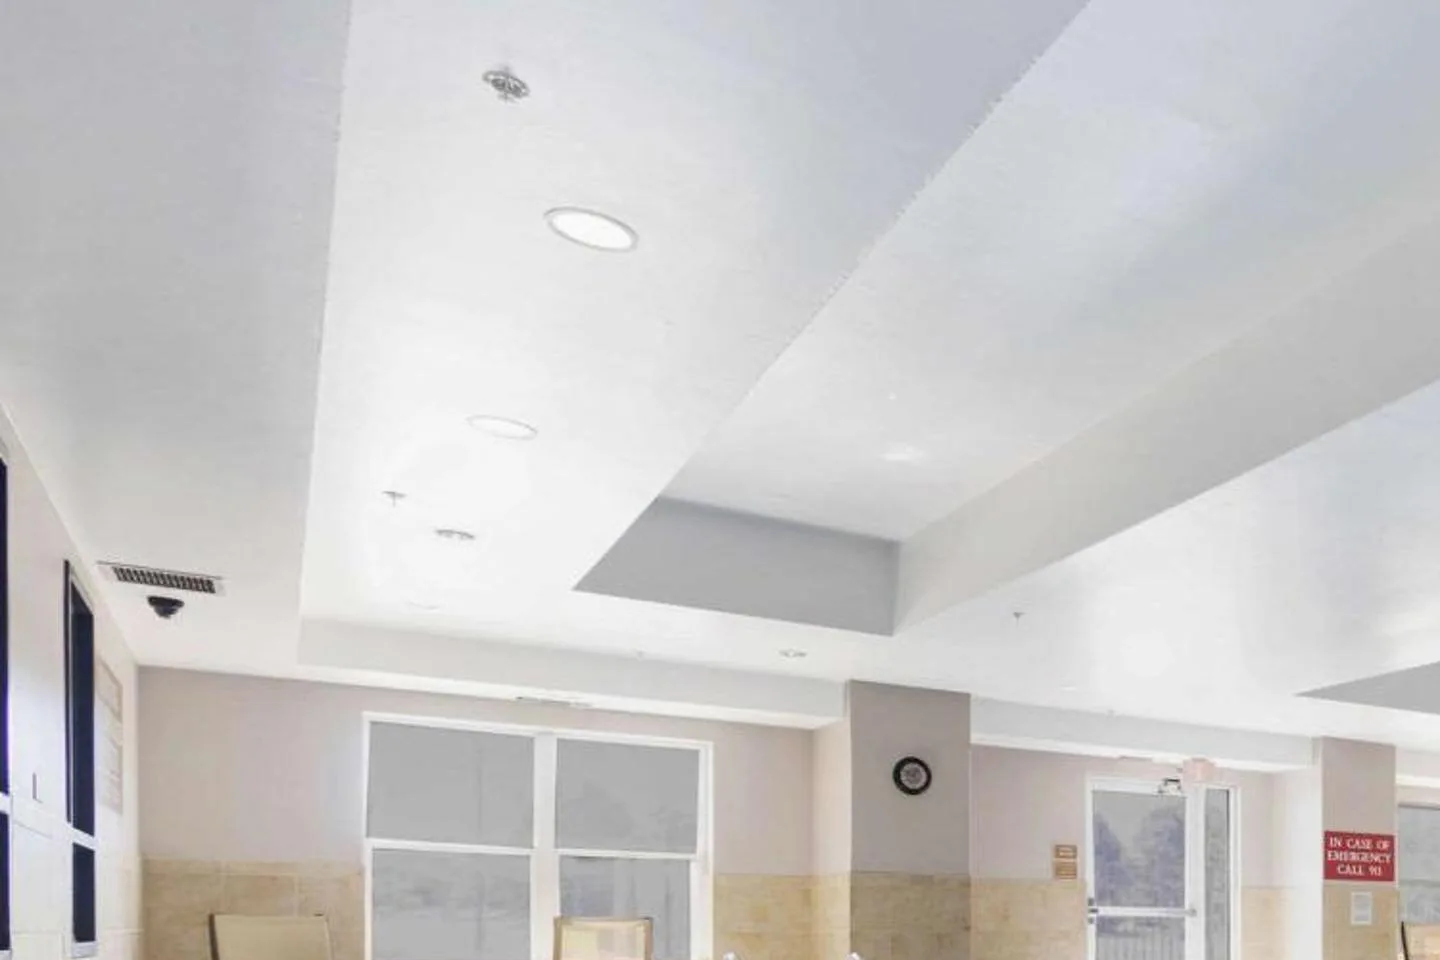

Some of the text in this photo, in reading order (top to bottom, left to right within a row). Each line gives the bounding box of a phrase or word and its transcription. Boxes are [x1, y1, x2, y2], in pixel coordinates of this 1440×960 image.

[1329, 837, 1390, 850] IN CASE OF
[1327, 850, 1391, 864] EMERGENCY
[1337, 864, 1364, 875] CALL
